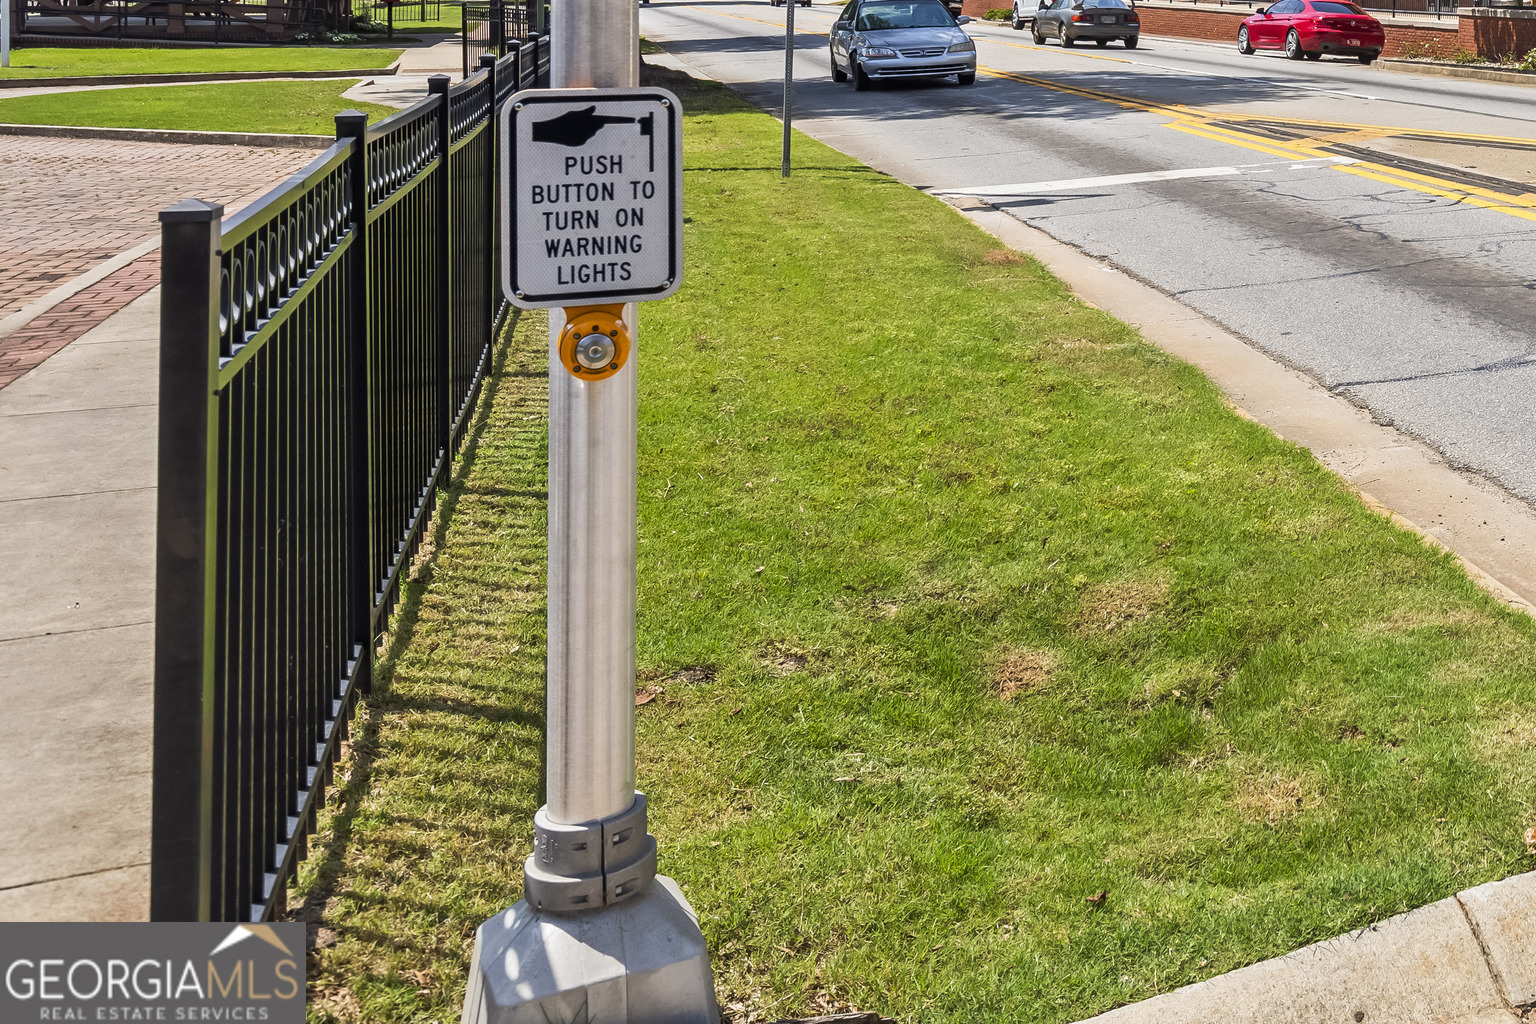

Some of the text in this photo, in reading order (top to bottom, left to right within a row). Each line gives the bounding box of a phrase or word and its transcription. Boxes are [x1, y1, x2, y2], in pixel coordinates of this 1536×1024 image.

[565, 154, 623, 176] PUSH
[532, 180, 655, 204] BUTTON TO
[542, 207, 643, 231] TURN ON
[545, 235, 642, 258] WARNING
[557, 262, 632, 285] LIGHTS
